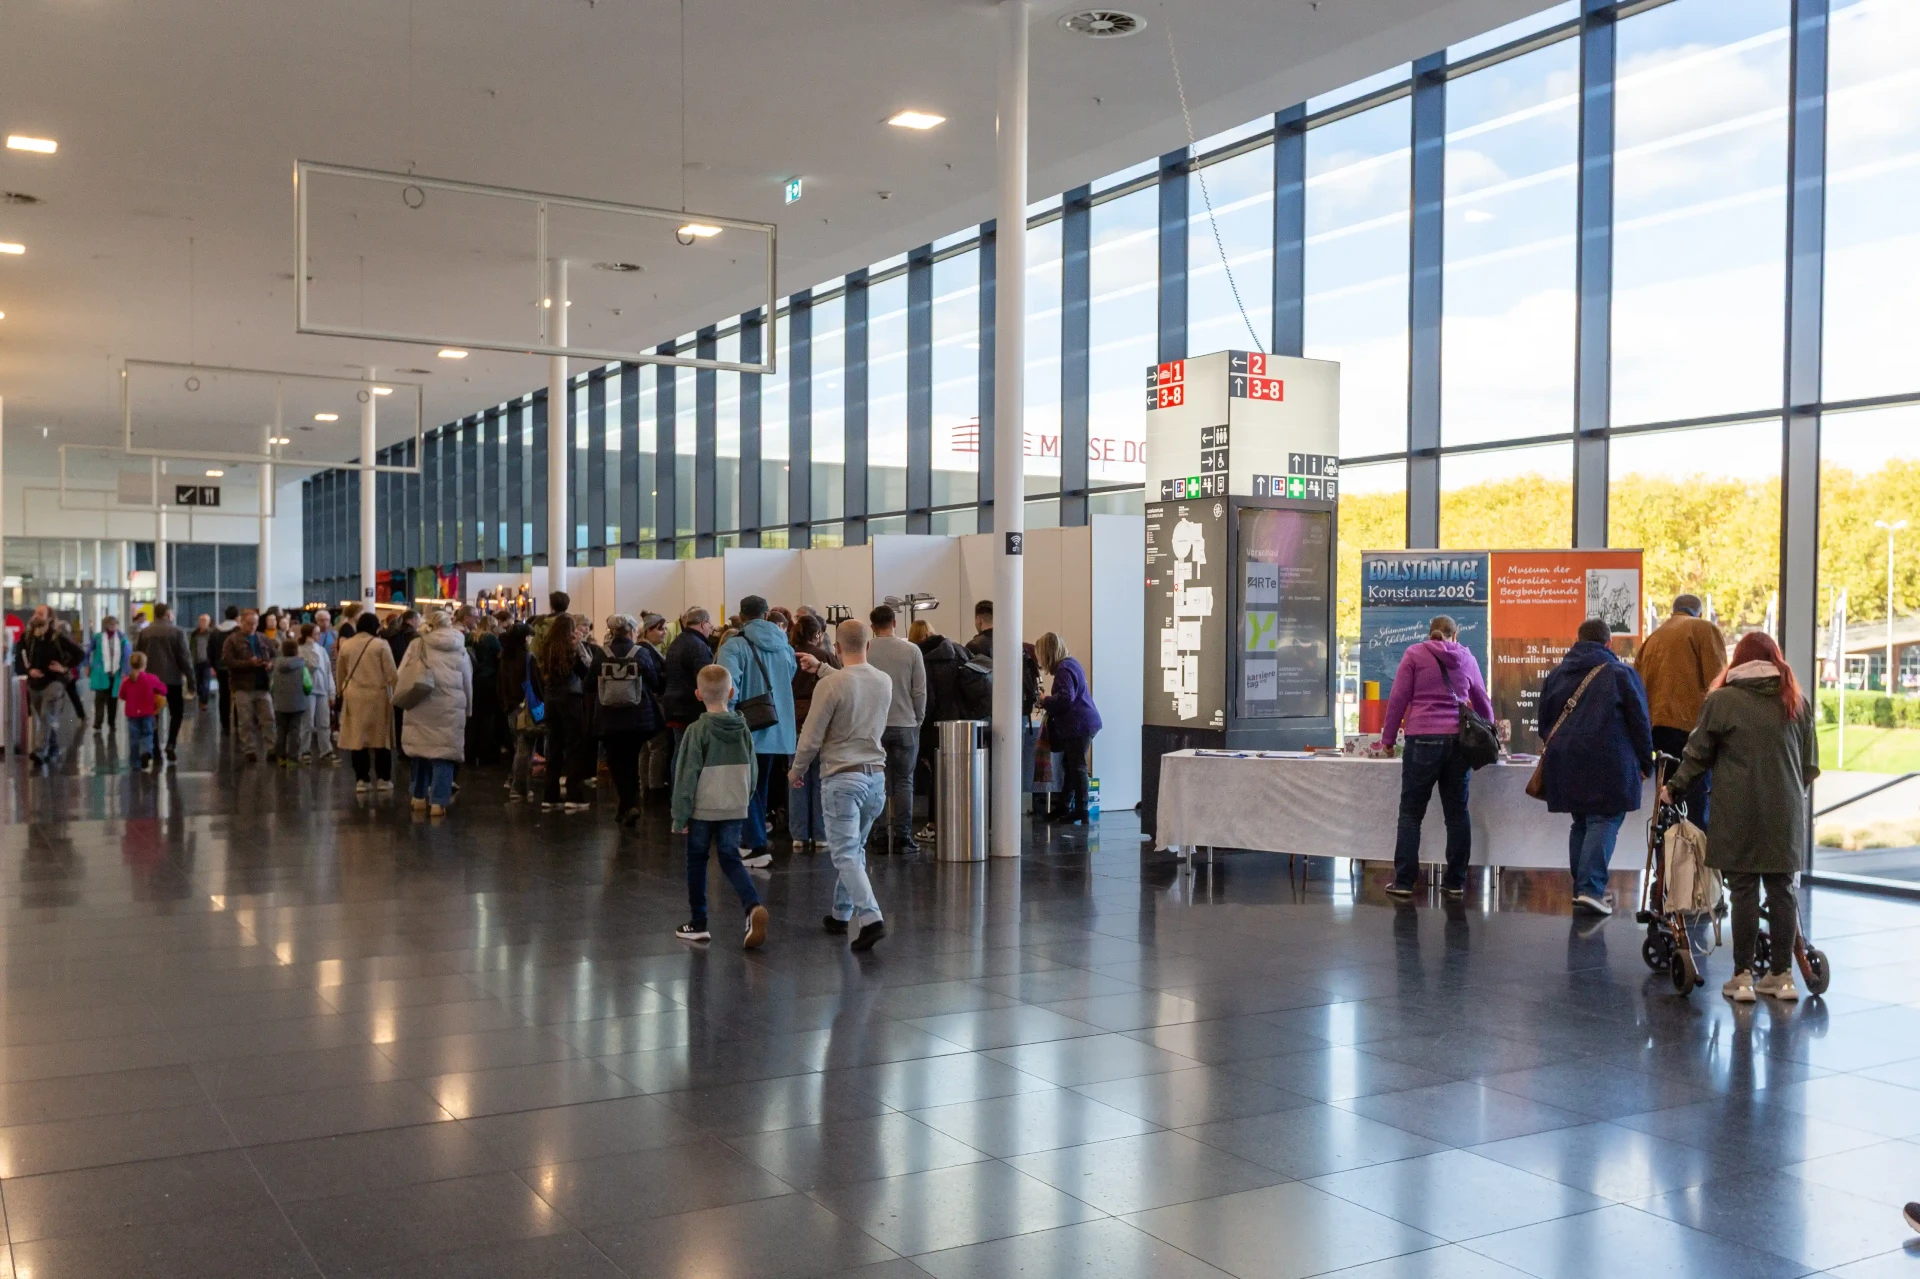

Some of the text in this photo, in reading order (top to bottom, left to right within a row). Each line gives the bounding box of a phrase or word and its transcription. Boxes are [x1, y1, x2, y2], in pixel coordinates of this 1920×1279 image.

[1173, 363, 1182, 381] 1
[1252, 355, 1263, 374] 2
[1160, 387, 1182, 407] 3-8
[1252, 380, 1280, 400] 3-8
[1369, 560, 1479, 581] EDELSTEINTAGE
[1508, 565, 1570, 574] Museum der
[1497, 576, 1582, 585] Mineralien- und
[1368, 581, 1475, 598] Konstanz 2026
[1500, 587, 1579, 597] Bergbaufreunde
[1526, 645, 1571, 654] 28. Intern
[1497, 655, 1550, 664] Mineralien-
